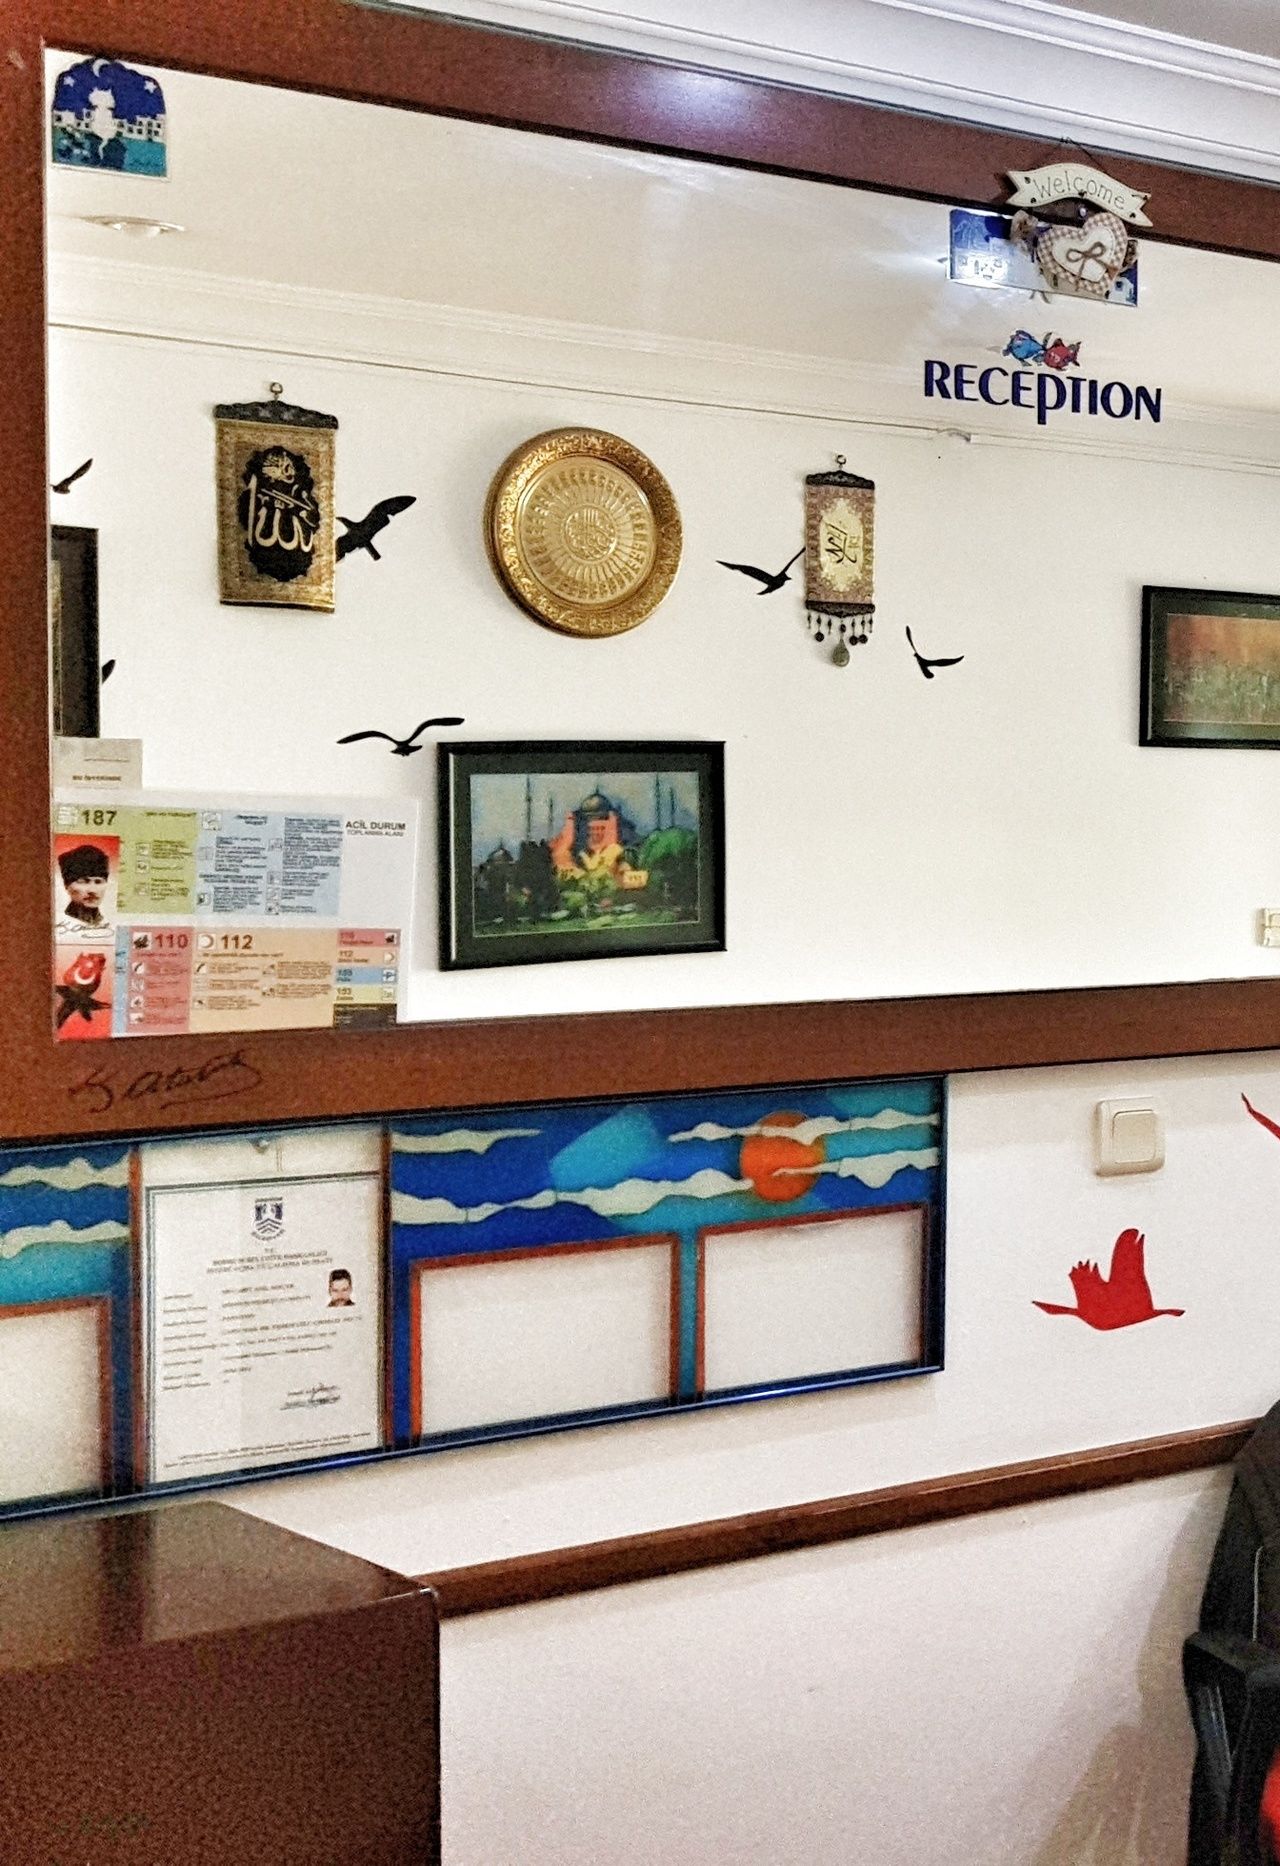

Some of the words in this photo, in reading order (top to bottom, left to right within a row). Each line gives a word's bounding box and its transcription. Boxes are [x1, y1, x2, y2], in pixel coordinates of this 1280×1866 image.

[924, 360, 1162, 425] RECEPTION
[82, 808, 118, 826] 187
[345, 819, 367, 830] ACİL
[370, 821, 406, 831] DURUM
[154, 934, 189, 949] 110
[219, 933, 253, 950] 112
